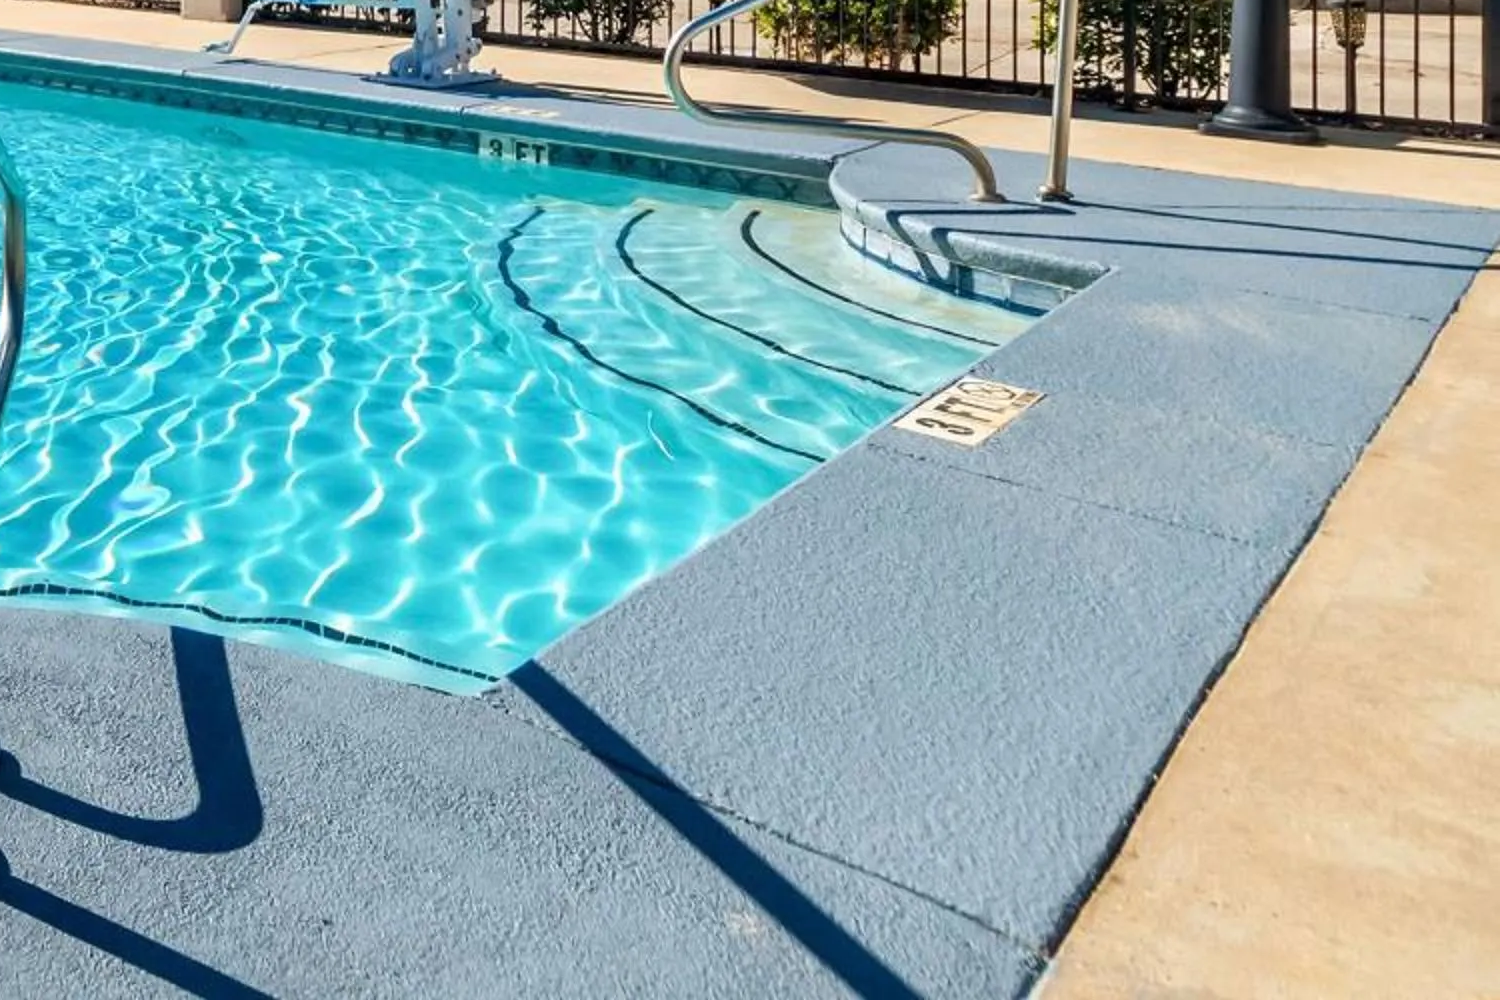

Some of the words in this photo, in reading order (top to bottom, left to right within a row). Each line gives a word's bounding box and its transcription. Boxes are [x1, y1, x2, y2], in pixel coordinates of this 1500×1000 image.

[515, 142, 546, 163] FT
[933, 396, 1005, 423] FT
[915, 417, 975, 436] 3
